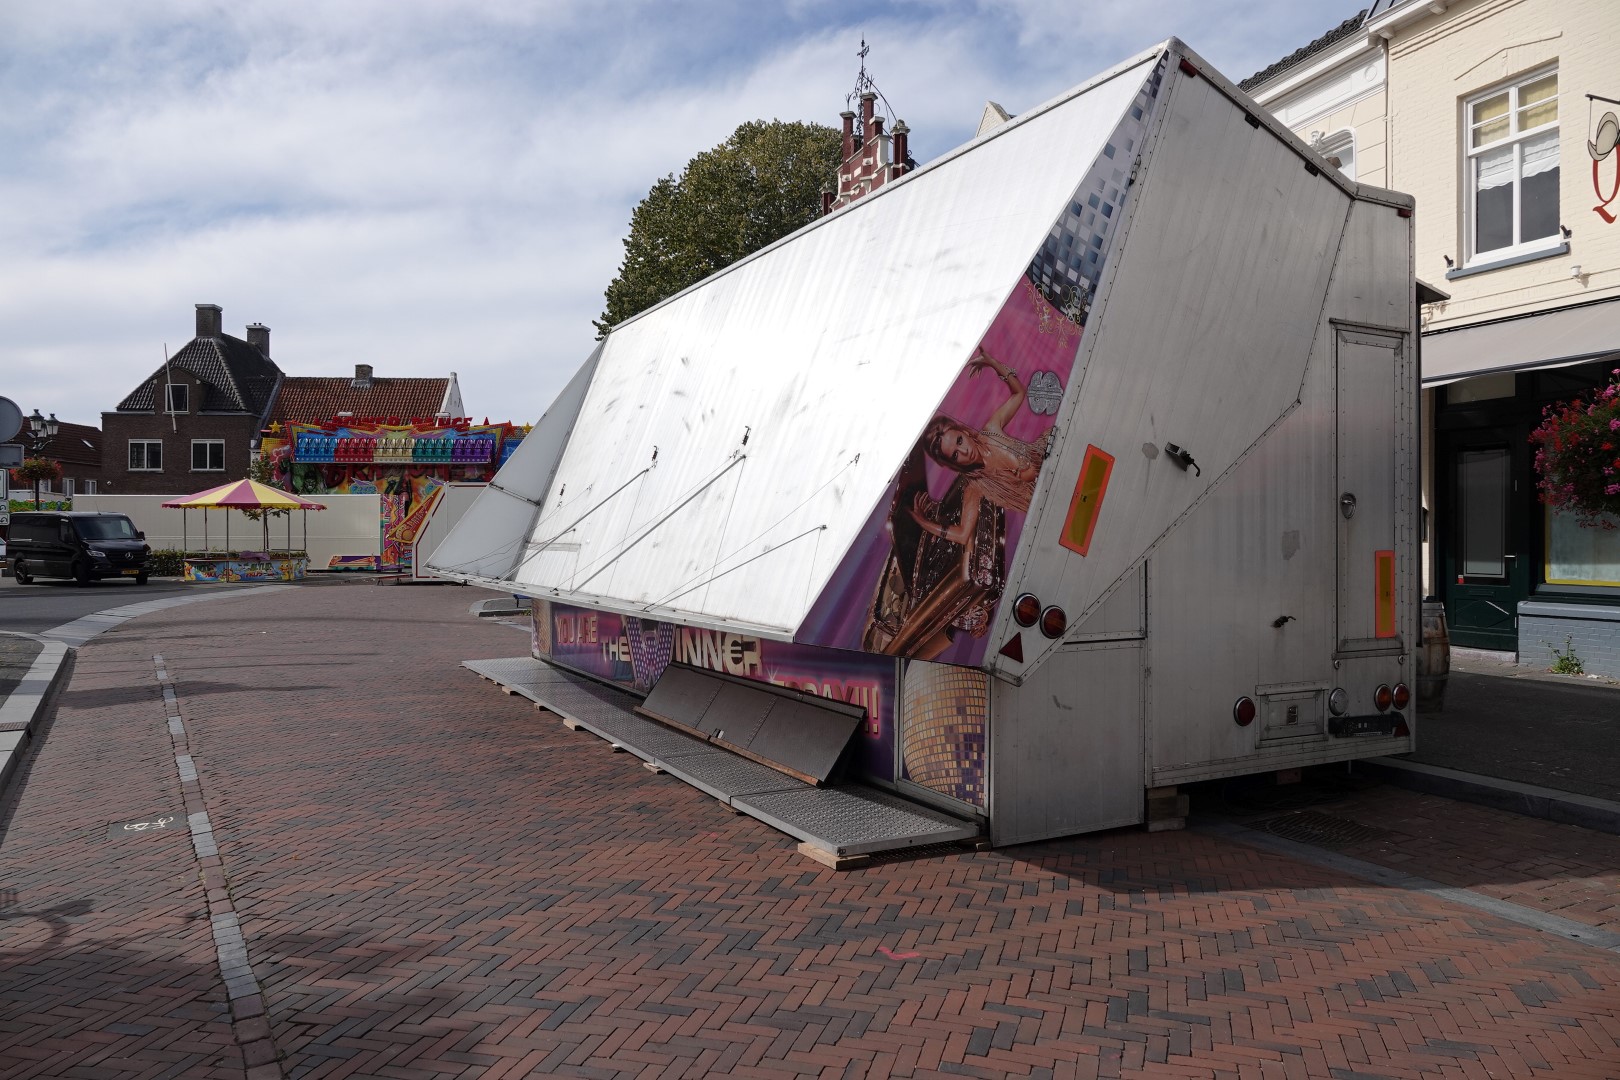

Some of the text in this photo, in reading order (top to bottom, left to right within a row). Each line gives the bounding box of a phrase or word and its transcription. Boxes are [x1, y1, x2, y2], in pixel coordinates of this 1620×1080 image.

[554, 612, 597, 644] YOU ARE
[600, 635, 632, 662] THE
